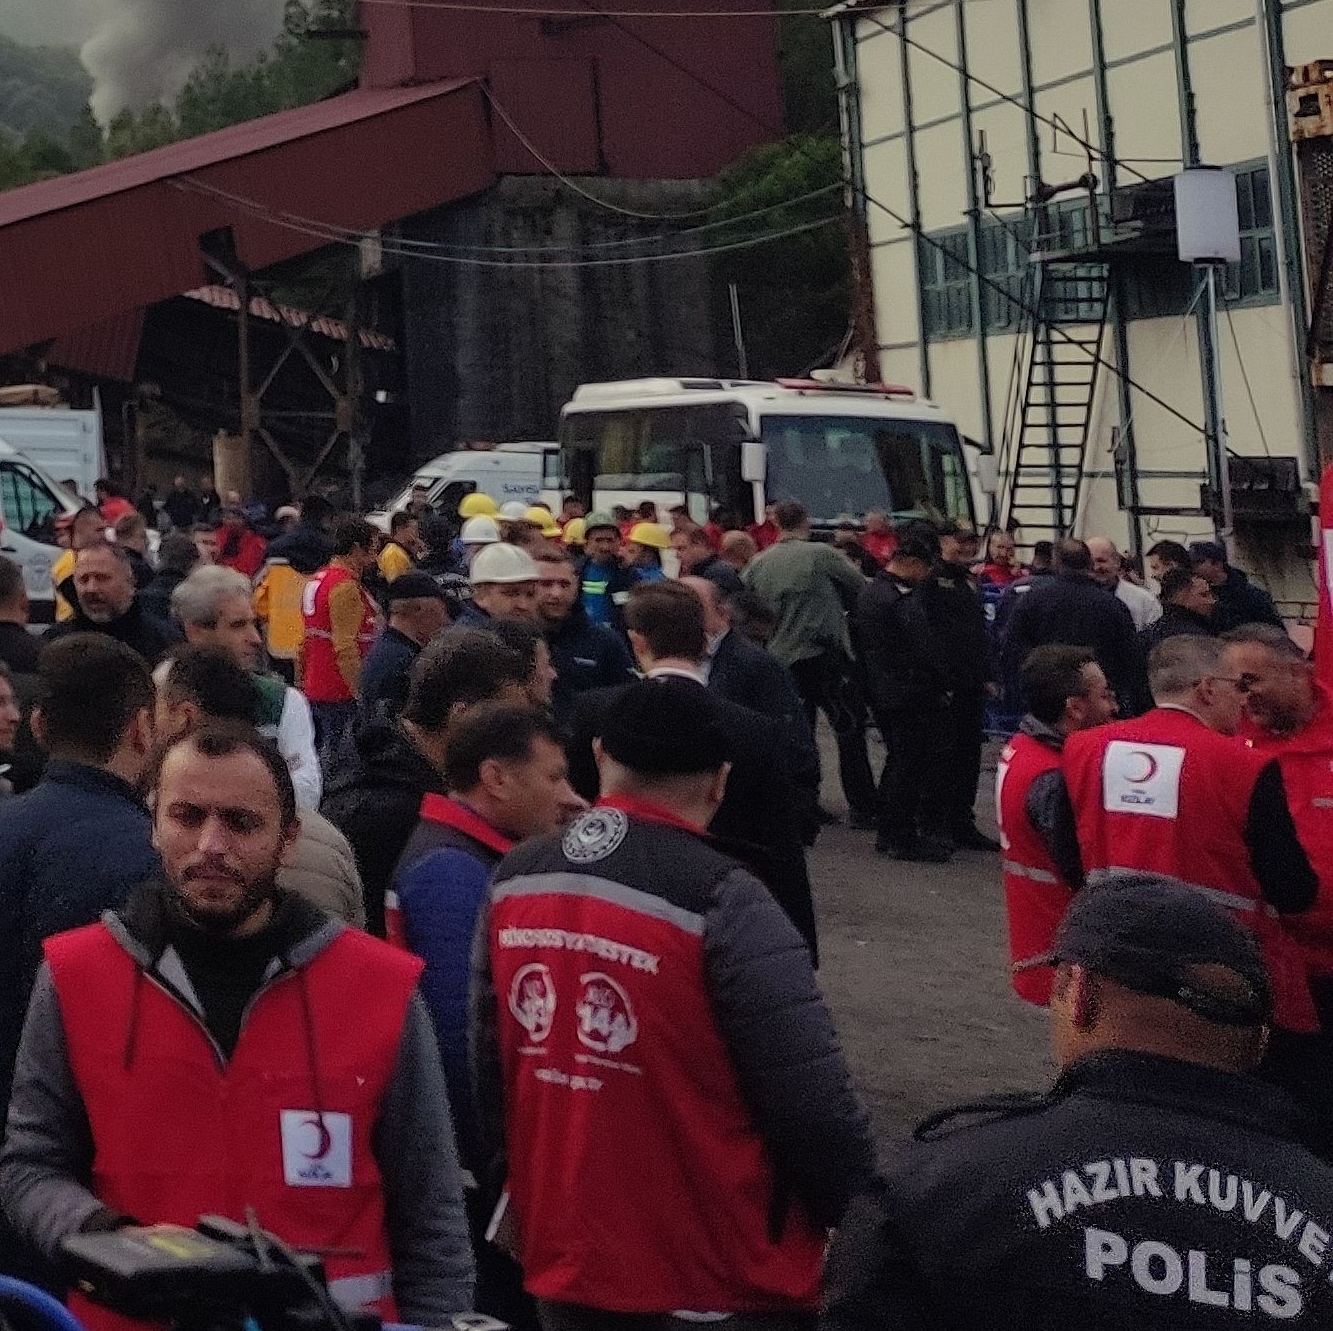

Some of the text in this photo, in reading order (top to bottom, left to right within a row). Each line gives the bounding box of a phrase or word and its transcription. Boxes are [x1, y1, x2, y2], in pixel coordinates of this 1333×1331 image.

[1027, 1157, 1333, 1282] HAZIR KUVVE
[1084, 1226, 1304, 1319] POLİS
